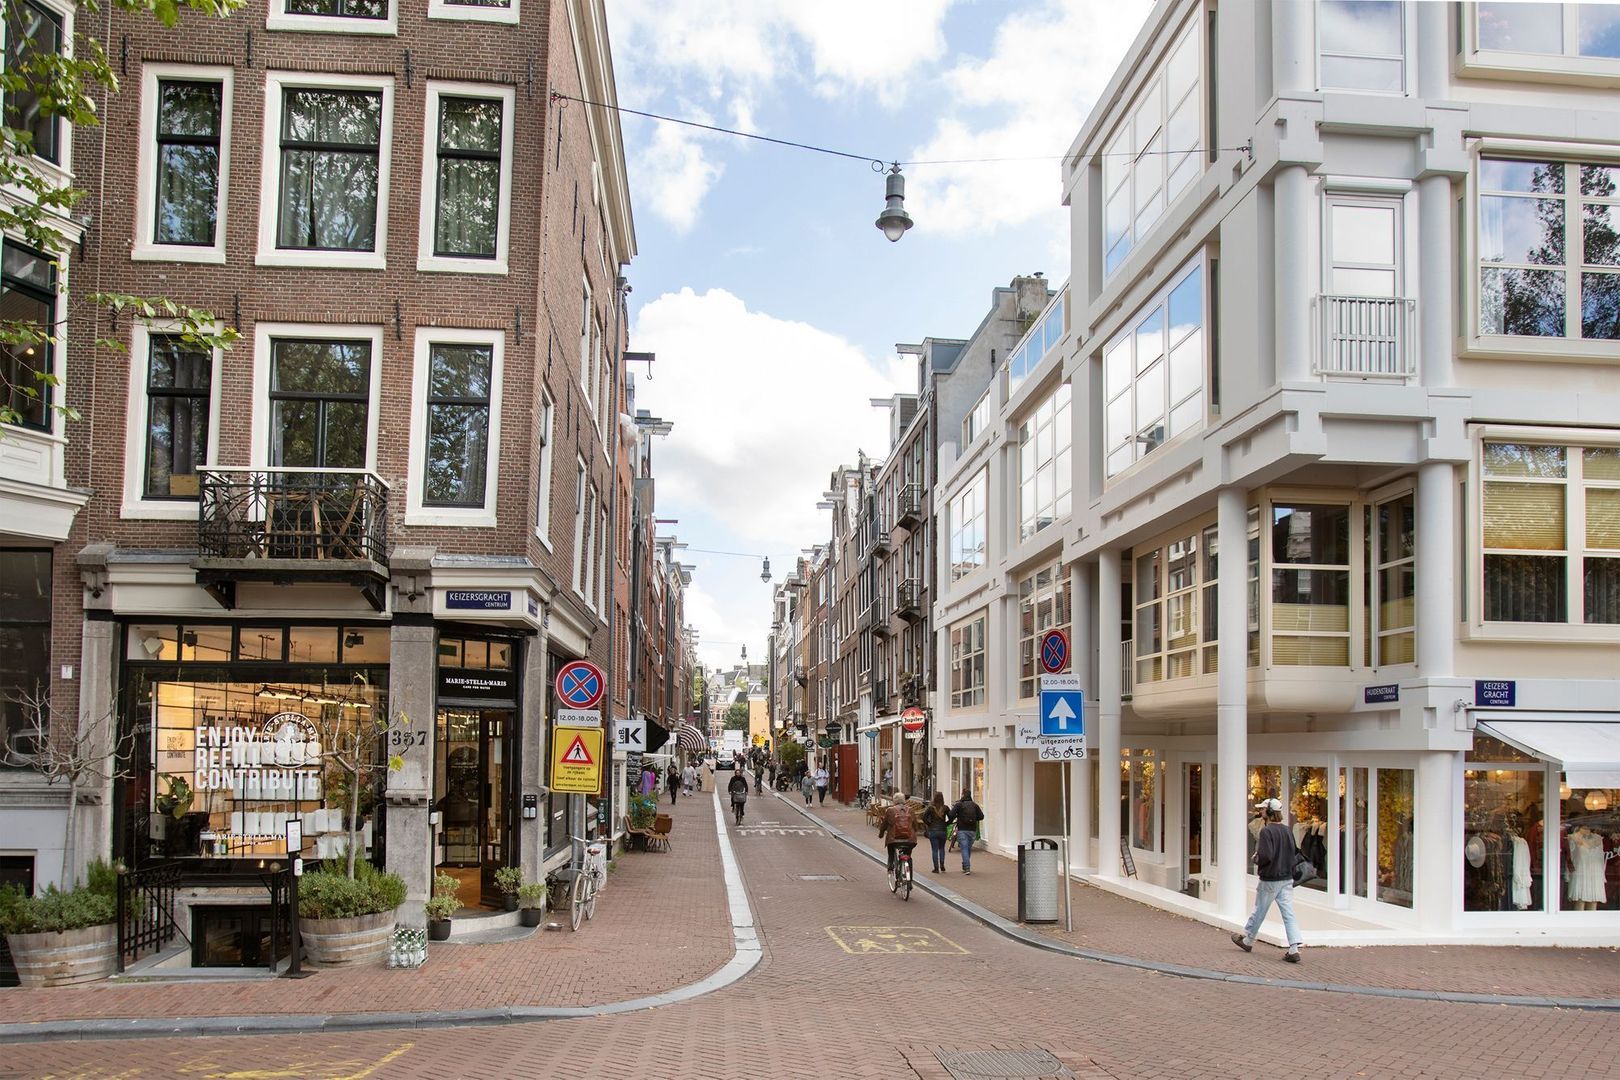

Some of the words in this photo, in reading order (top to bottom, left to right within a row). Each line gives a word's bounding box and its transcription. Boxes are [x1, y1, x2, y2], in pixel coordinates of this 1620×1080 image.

[449, 592, 508, 601] KEIZERSGRACHT
[445, 678, 507, 686] MARIE-STELLA-MARIS
[1483, 682, 1509, 690] KEIZERS
[1483, 690, 1509, 698] GRACHT
[196, 726, 257, 747] ENJOY
[391, 730, 426, 746] 357
[624, 727, 642, 744] K
[1040, 738, 1083, 746] uitgezonderd
[195, 748, 262, 769] REFILL
[195, 769, 319, 790] CONTRIBUTE
